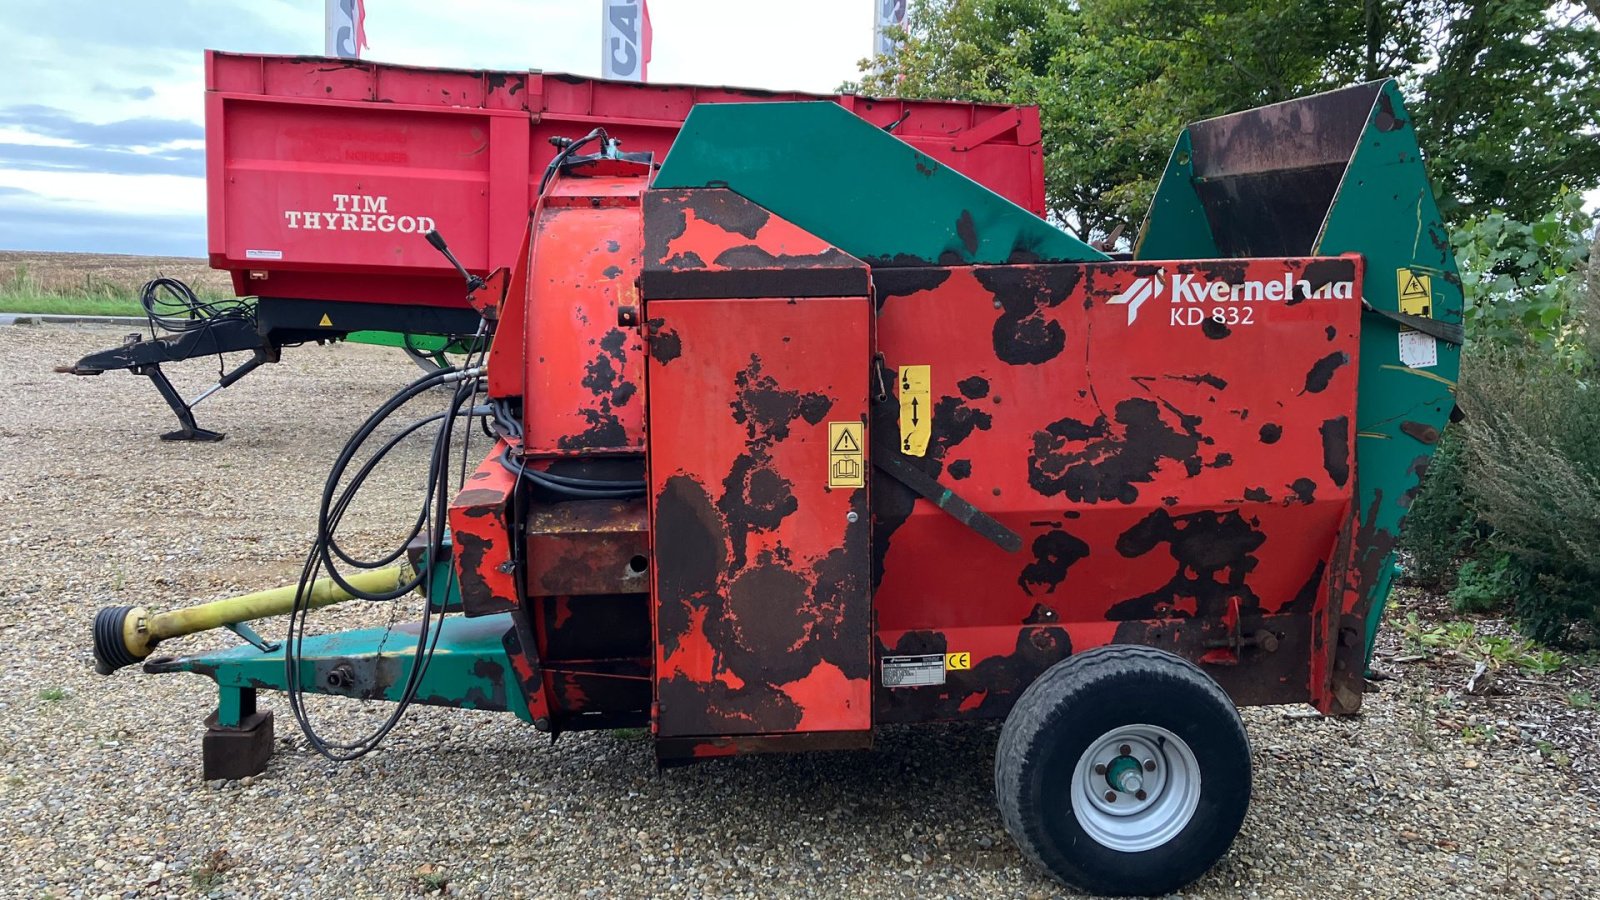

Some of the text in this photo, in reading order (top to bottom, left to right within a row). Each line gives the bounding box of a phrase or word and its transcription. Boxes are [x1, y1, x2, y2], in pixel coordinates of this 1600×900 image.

[610, 0, 637, 76] CA
[333, 194, 388, 213] TIM
[284, 211, 436, 234] THYREGOD
[1170, 306, 1255, 326] KD 832
